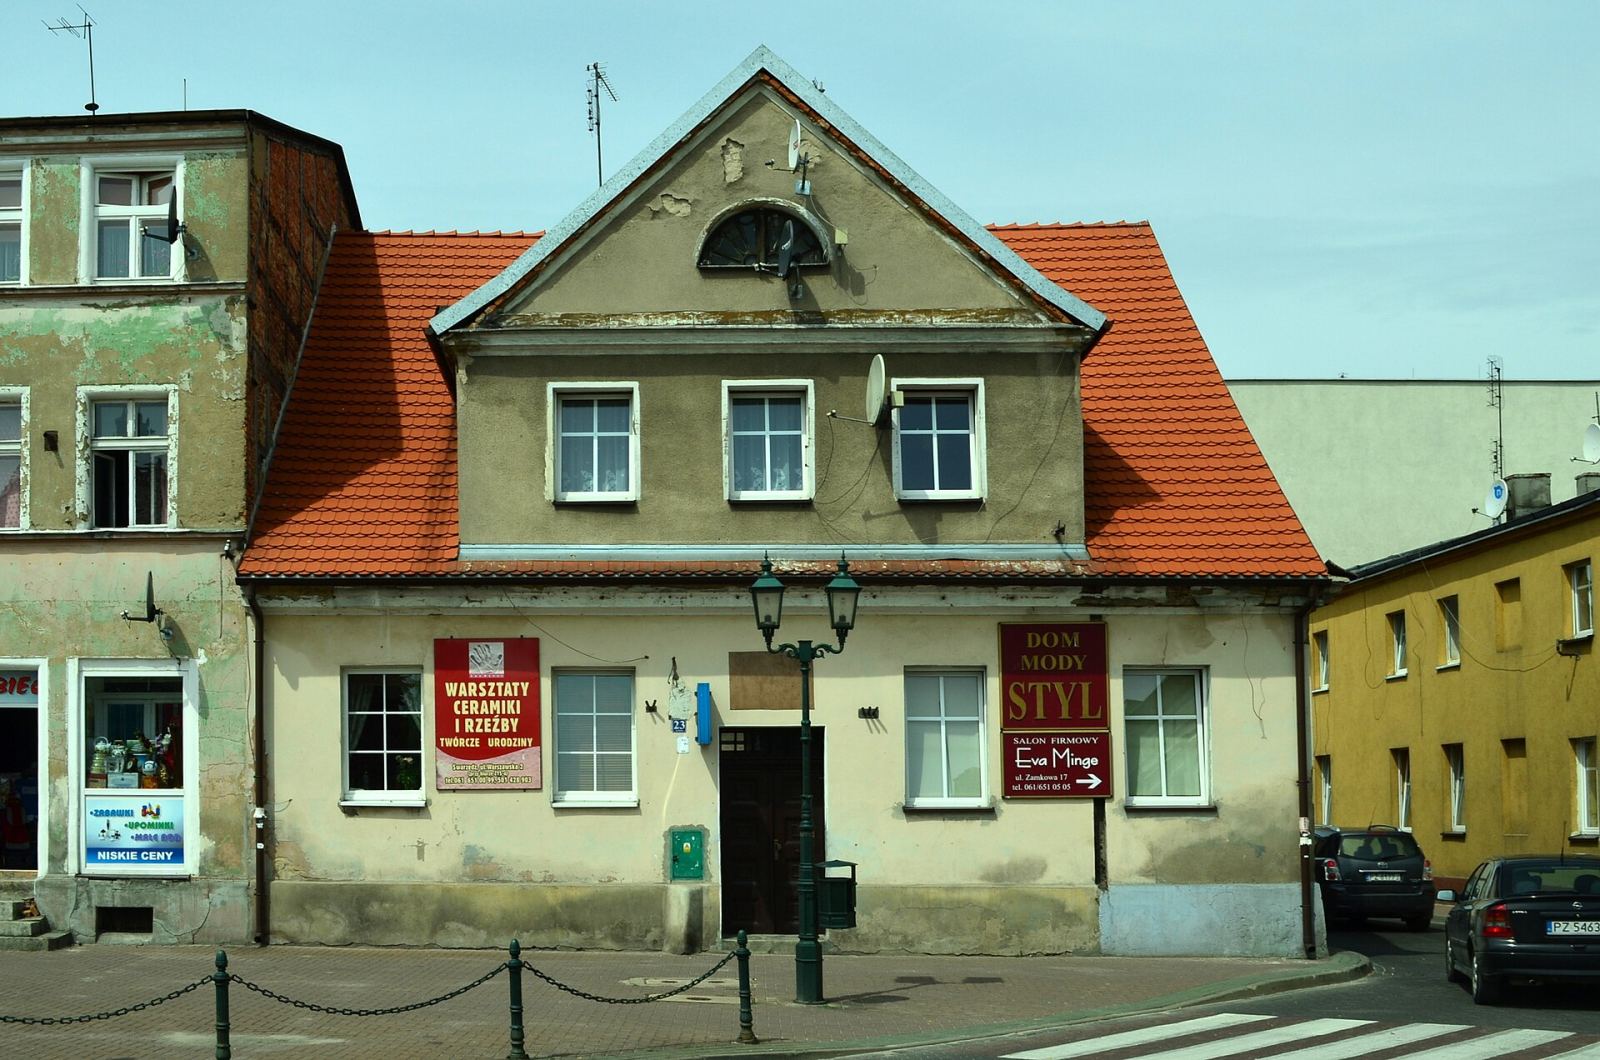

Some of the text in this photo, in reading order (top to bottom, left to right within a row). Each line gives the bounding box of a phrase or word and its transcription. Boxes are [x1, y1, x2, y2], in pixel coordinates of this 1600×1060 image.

[1026, 631, 1080, 649] DOM
[1020, 654, 1088, 671] MODY
[445, 682, 530, 697] WARSZTATY
[1008, 680, 1102, 720] STYL
[453, 699, 521, 715] CERAMIKI
[455, 714, 519, 733] I RZEŹBY
[674, 720, 686, 730] 23
[439, 736, 533, 748] TWÓRCZE URODZINY
[1013, 736, 1099, 745] SALON FIRMOWY
[1014, 747, 1099, 770] Eva Minge
[1025, 773, 1058, 781] Zamkowa
[1060, 773, 1068, 781] 17
[93, 809, 134, 817] ZABAWKI
[128, 821, 174, 829] UPOMINKI
[97, 851, 174, 860] NISKIE CENY
[1554, 922, 1570, 932] PZ
